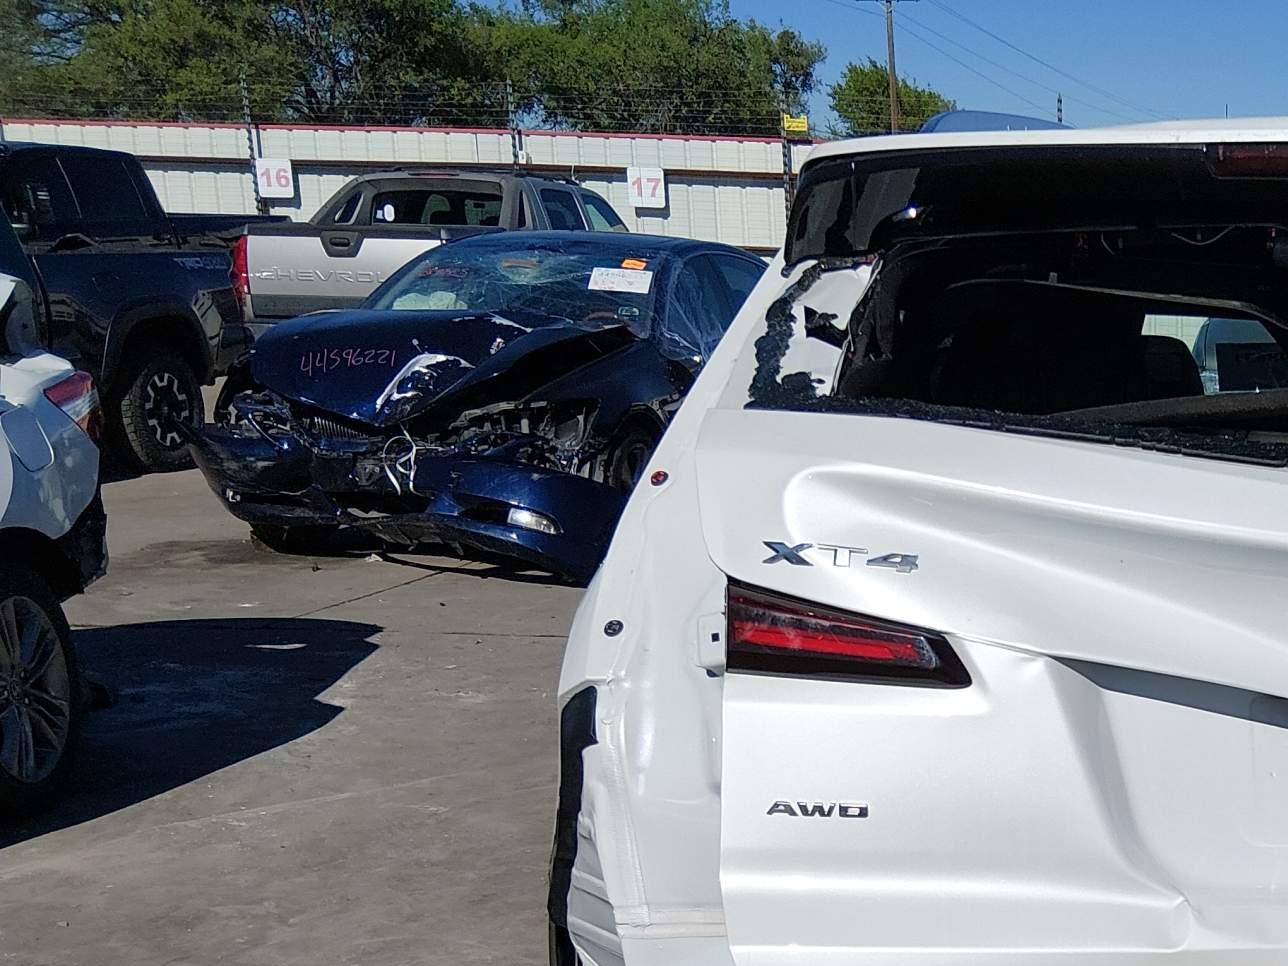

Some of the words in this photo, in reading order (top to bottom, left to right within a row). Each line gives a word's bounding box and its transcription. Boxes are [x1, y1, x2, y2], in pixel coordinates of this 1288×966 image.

[260, 167, 290, 188] 16
[632, 177, 661, 198] 17
[300, 348, 396, 376] 44596221
[761, 540, 919, 574] XT4
[766, 800, 869, 818] AWD
